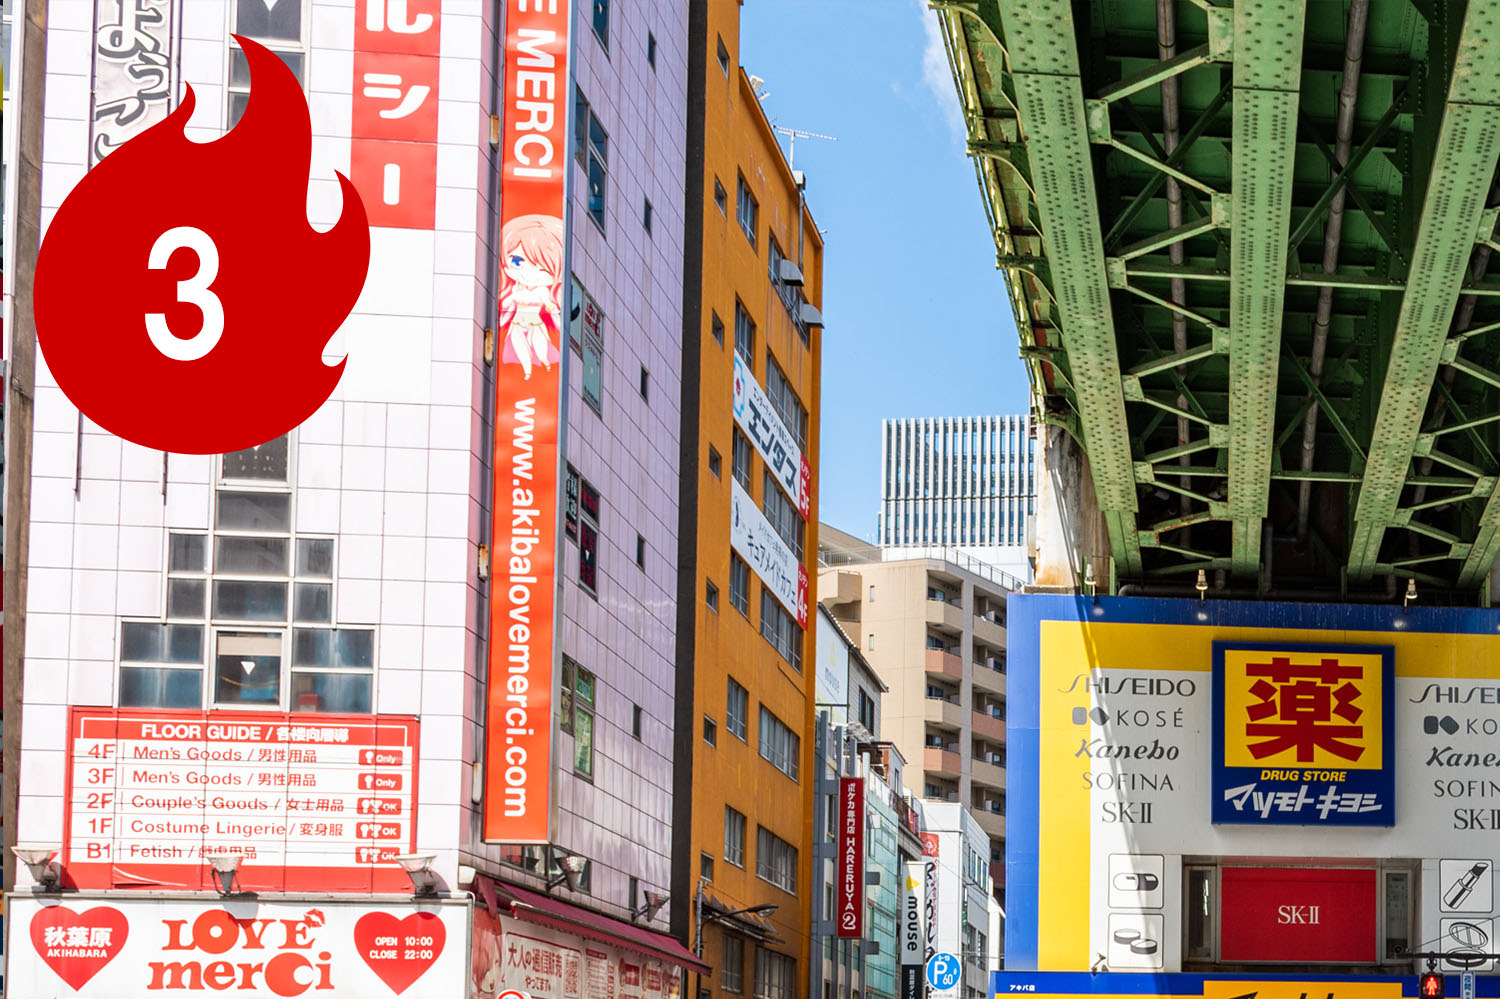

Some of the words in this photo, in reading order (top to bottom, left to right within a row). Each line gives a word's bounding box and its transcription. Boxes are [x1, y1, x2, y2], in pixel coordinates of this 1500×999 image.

[512, 28, 556, 178] MERCI
[504, 397, 540, 818] www.akibalovemerci.com
[1057, 673, 1197, 698] SHISEIDO
[1116, 707, 1184, 728] KOSÉ
[1246, 657, 1366, 763] 薬
[141, 723, 201, 738] FLOOR
[206, 725, 261, 740] GUIDE
[88, 743, 115, 759] 4F
[133, 746, 180, 759] Men's
[186, 747, 242, 761] Goods
[258, 749, 317, 763] 男性用品
[1074, 738, 1181, 763] Kanebo
[87, 768, 115, 784] 3F
[132, 770, 180, 784] Men's
[186, 771, 242, 785] Goods
[258, 773, 317, 787] 男性用品
[375, 778, 396, 789] Only
[1081, 771, 1175, 793] SOFINA
[1260, 769, 1300, 783] DRUG
[1303, 770, 1347, 784] STORE
[86, 793, 113, 809] 2F
[131, 795, 206, 811] Couple's
[212, 797, 268, 811] Goods
[382, 803, 398, 811] OK
[88, 818, 113, 834] 1F
[130, 819, 210, 833] Costume
[216, 821, 286, 837] Lingerie
[382, 827, 397, 836] OK
[87, 842, 111, 859] B1
[130, 844, 182, 859] Fetish
[845, 837, 855, 911] HARERUYA
[842, 911, 856, 930] 2
[908, 896, 918, 951] mouse
[44, 925, 114, 948] 秋葉原
[161, 908, 318, 955] LOVE
[375, 936, 398, 946] OPEN
[404, 936, 433, 947] 10:00
[46, 948, 108, 959] AKIHABARA
[369, 949, 398, 960] CLOSE
[404, 949, 433, 960] 22:00
[933, 961, 948, 985] P
[942, 973, 954, 985] 60
